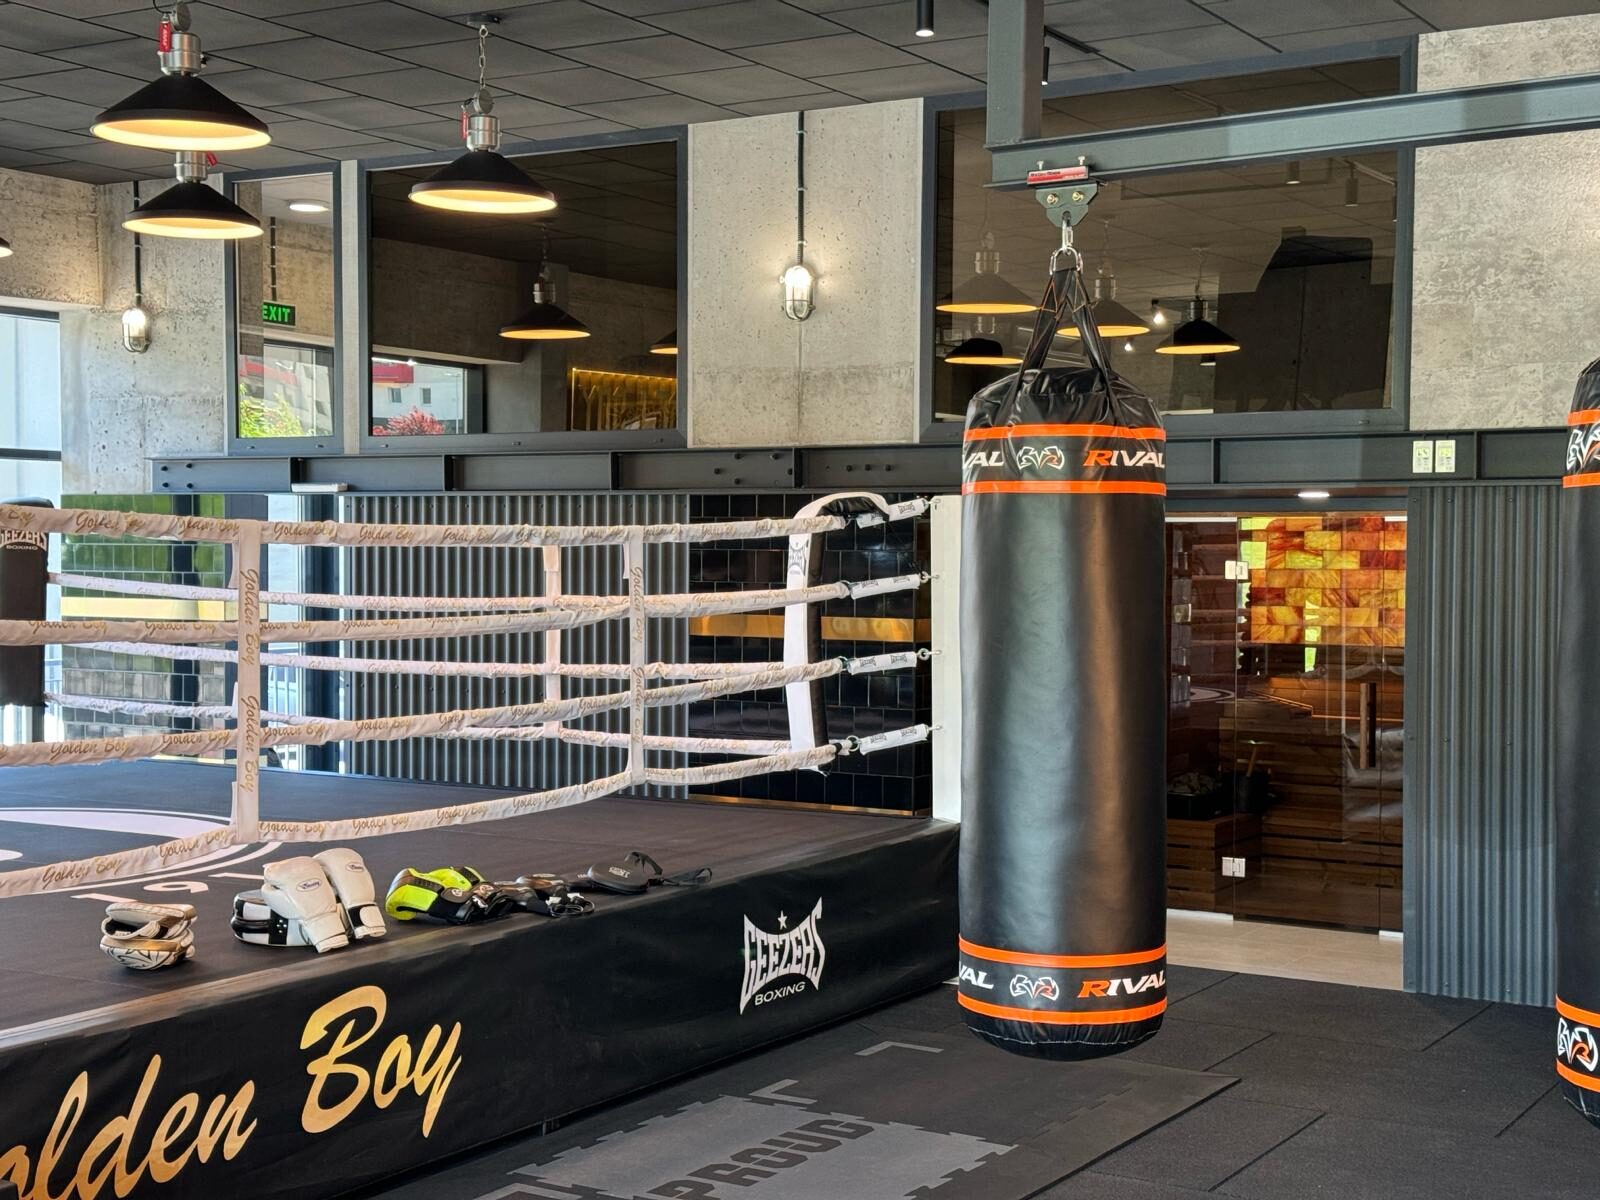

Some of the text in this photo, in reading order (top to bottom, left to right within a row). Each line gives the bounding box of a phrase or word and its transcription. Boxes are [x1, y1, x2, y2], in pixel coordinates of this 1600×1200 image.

[263, 304, 290, 322] EXIT
[1083, 450, 1165, 468] RIVAL
[240, 568, 259, 626] Golden
[241, 695, 259, 754] Golden
[740, 897, 825, 1015] GEEZERS
[1077, 969, 1166, 998] RIVAL
[755, 982, 806, 1006] BOXING
[301, 985, 461, 1138] Boy
[648, 1119, 876, 1200] PROUD
